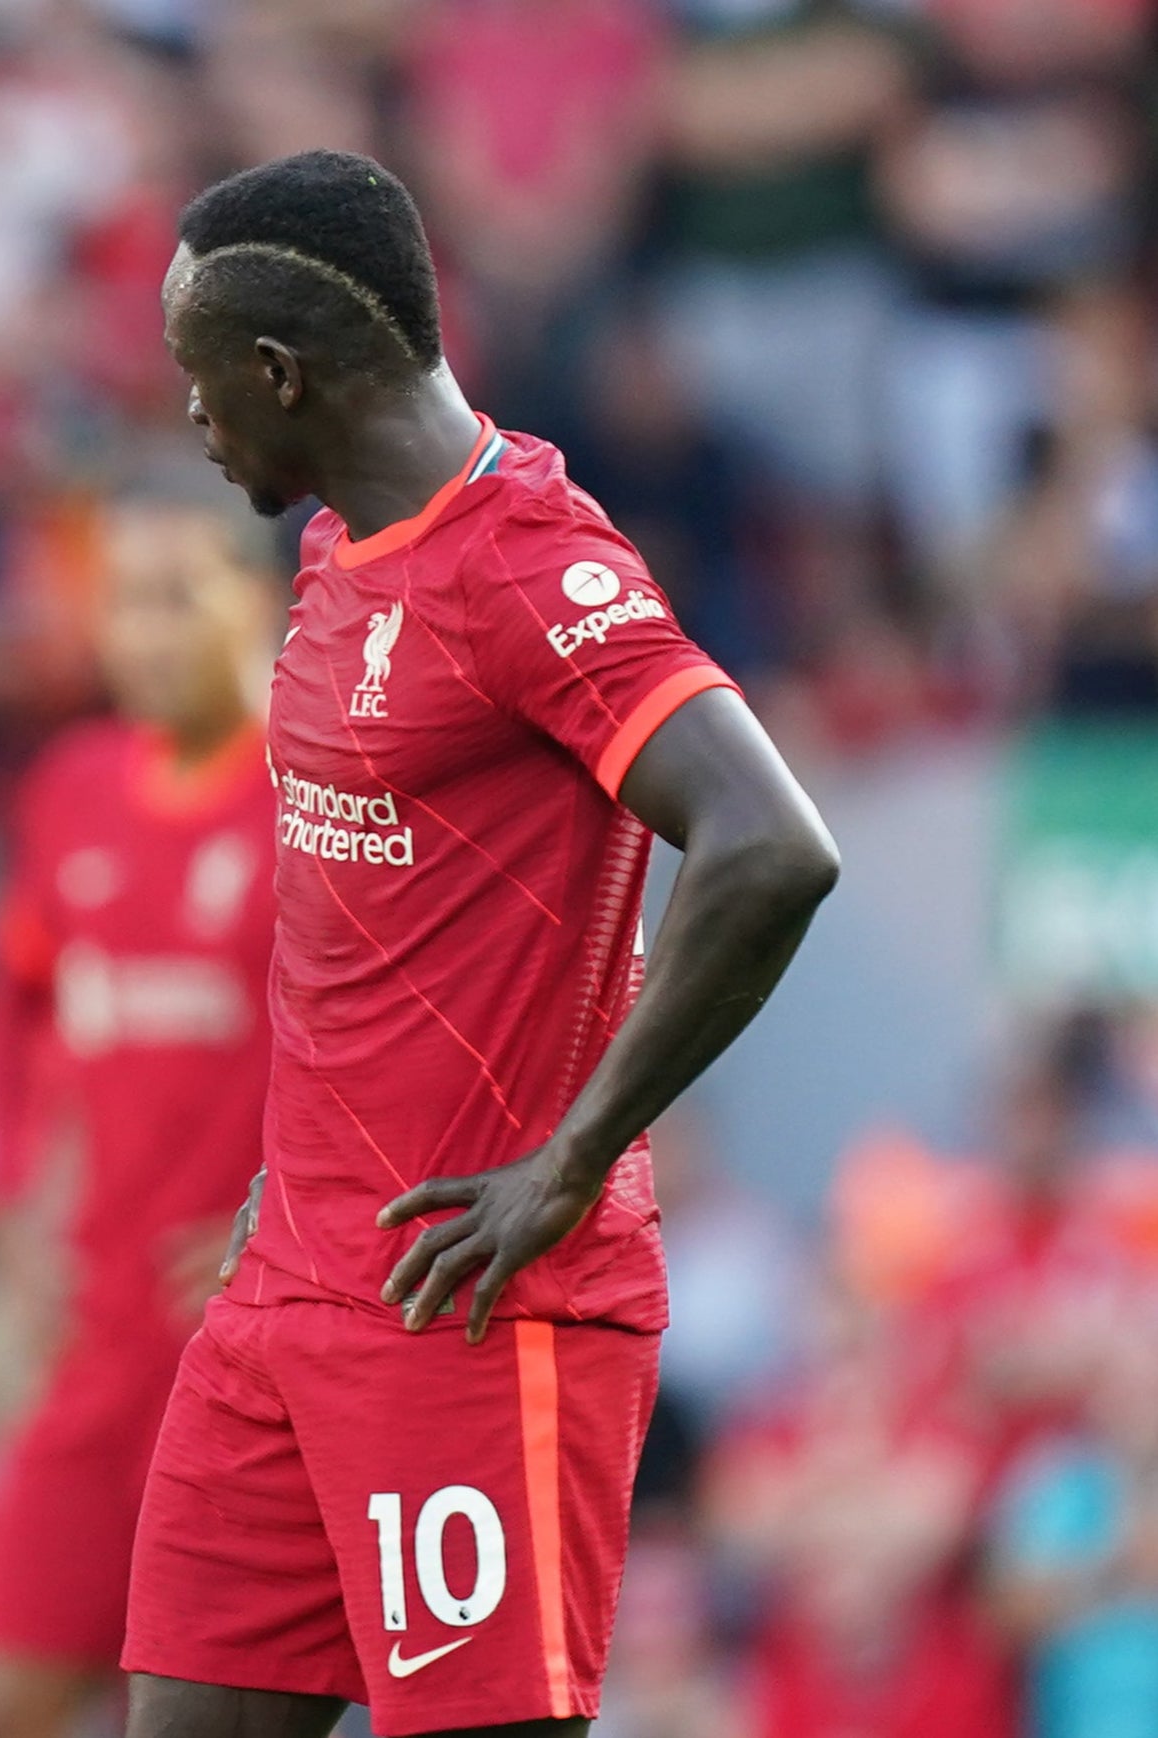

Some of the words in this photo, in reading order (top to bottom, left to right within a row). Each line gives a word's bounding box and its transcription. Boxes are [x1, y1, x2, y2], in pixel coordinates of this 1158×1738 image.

[545, 590, 666, 658] Expedia
[282, 769, 399, 826] standard
[282, 809, 414, 866] chartered
[368, 1485, 507, 1632] 10
